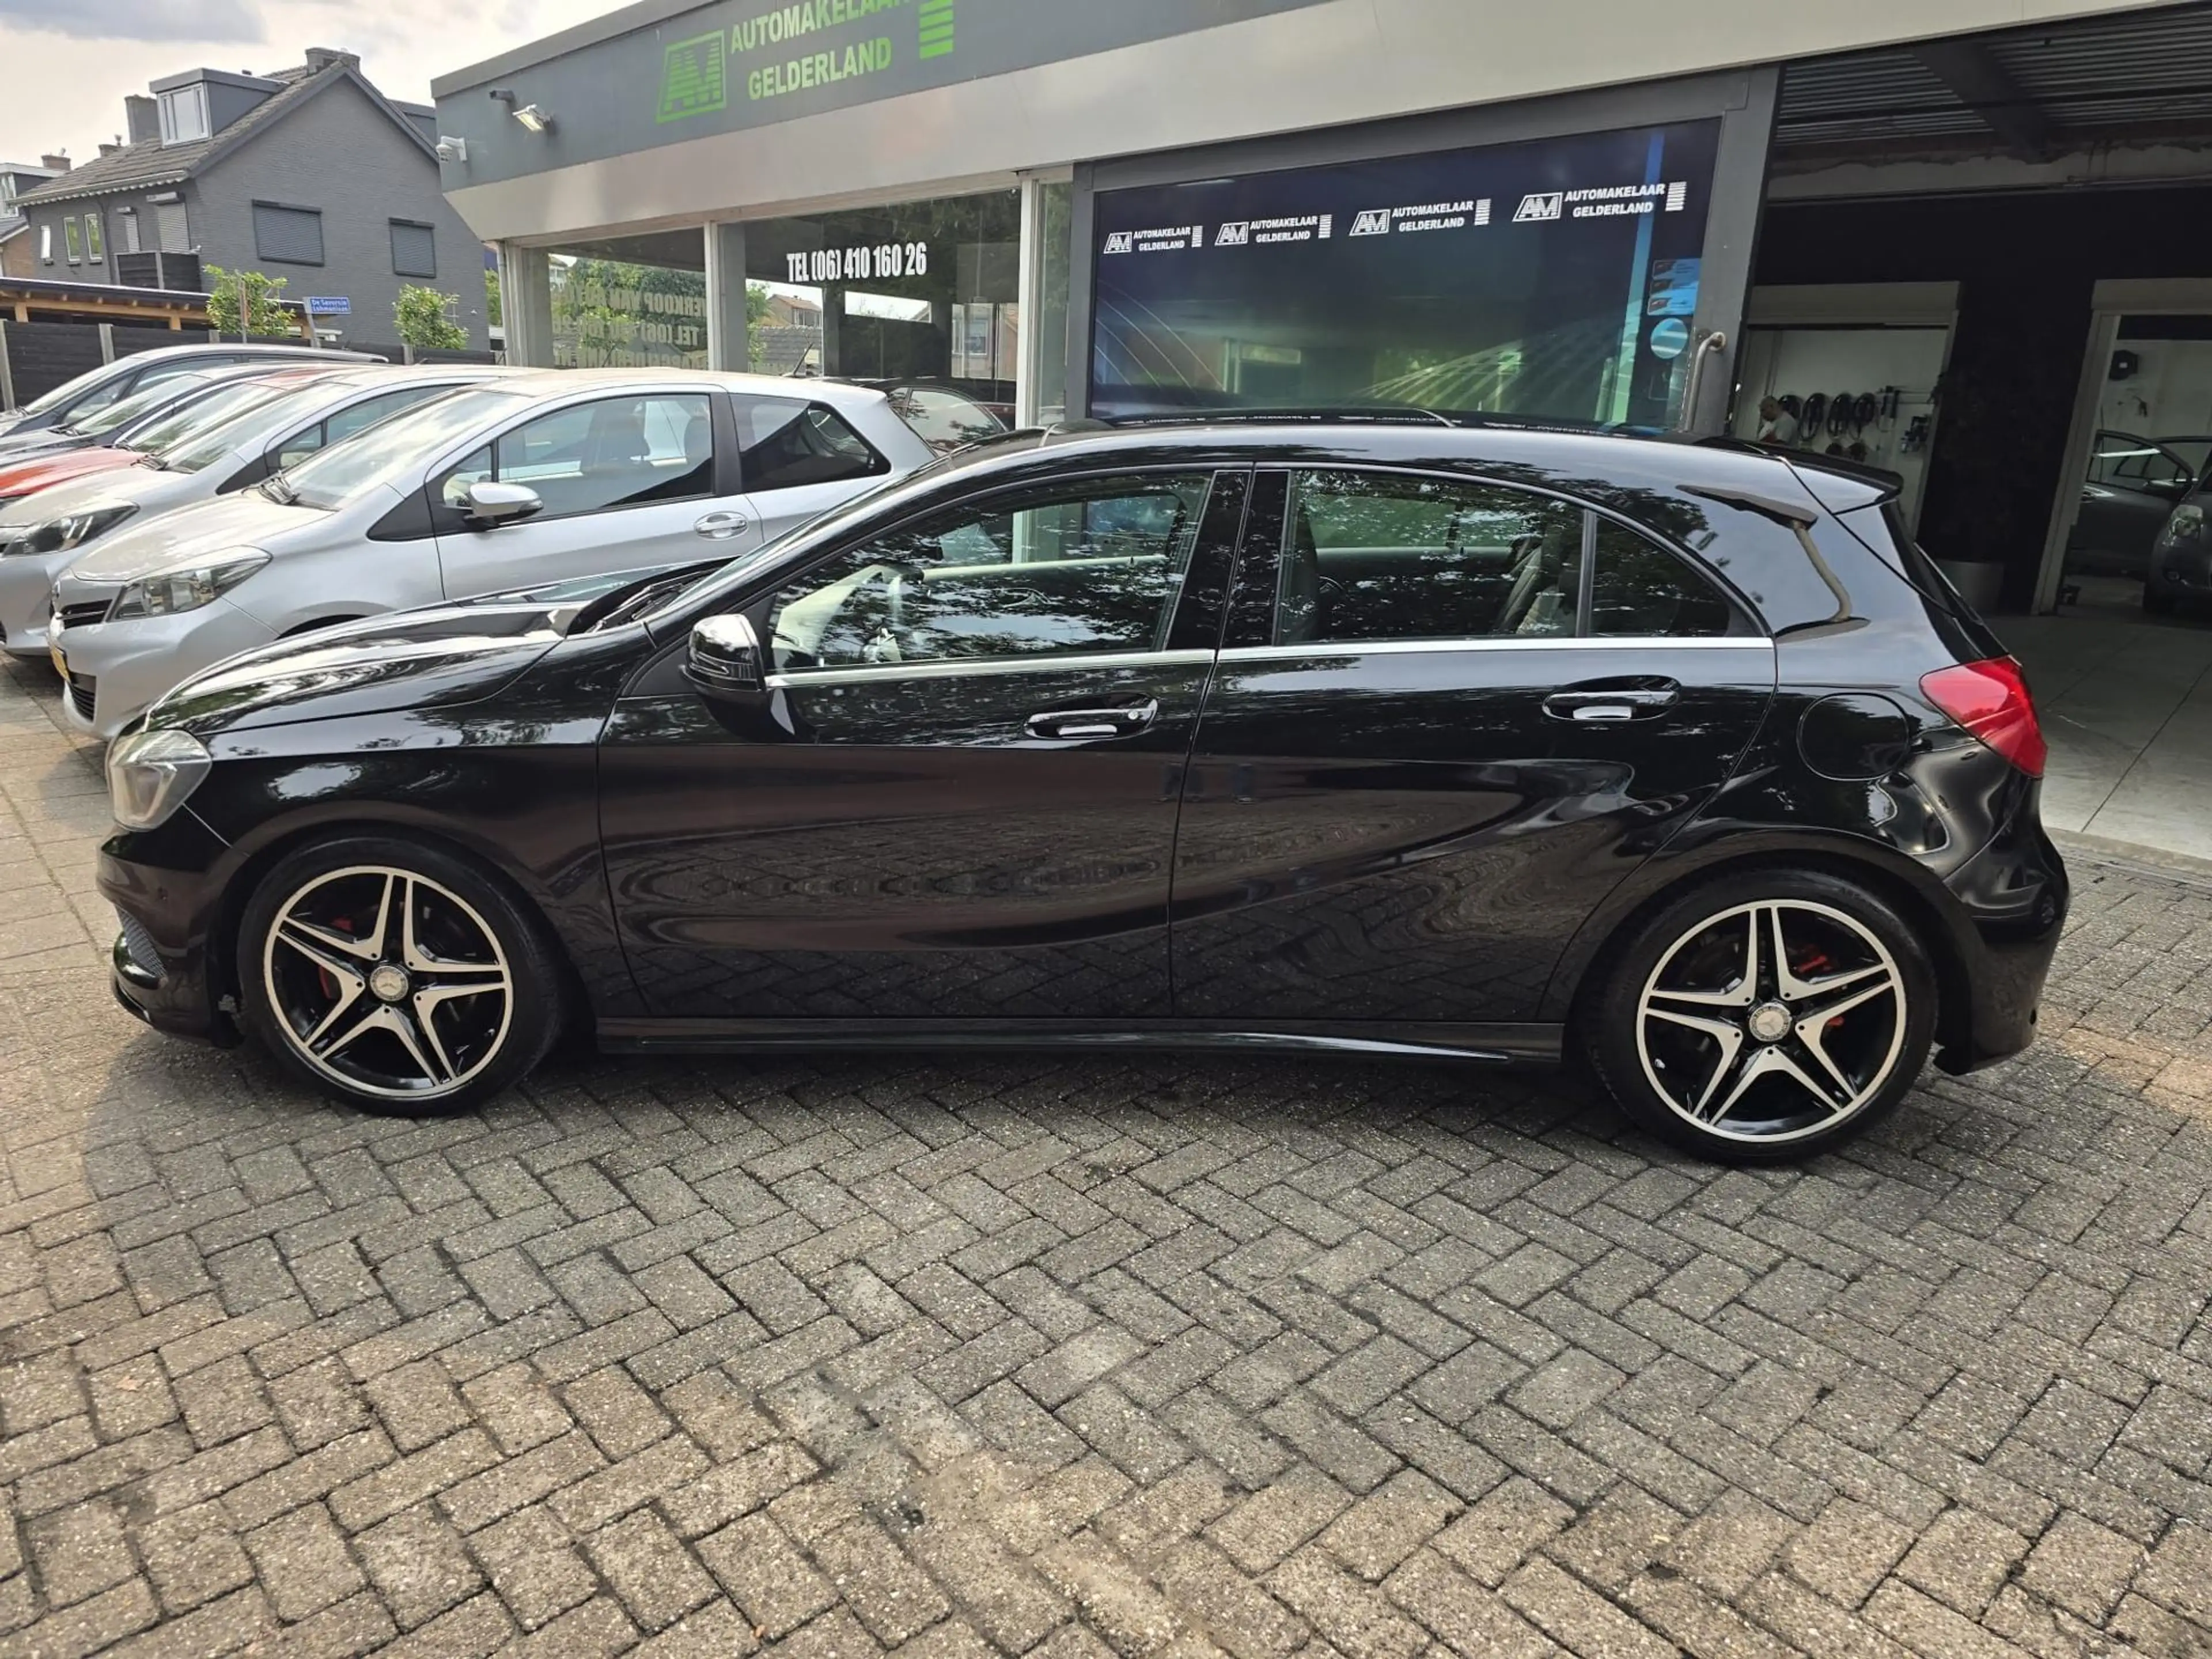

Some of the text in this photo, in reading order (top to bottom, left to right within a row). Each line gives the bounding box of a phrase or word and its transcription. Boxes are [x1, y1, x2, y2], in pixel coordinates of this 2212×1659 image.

[749, 37, 892, 100] GELDERLAND
[1565, 183, 1665, 202] AUTOMAKELAAR
[1392, 200, 1474, 217] AUTOMAKELAAR
[1573, 202, 1653, 218] GELDERLAND
[1250, 216, 1318, 230] AUTOMAKELAAR
[1399, 217, 1464, 232] GELDERLAND
[1134, 226, 1191, 240] AUTOMAKELAAR
[1256, 231, 1310, 243] GELDERLAND
[1138, 240, 1185, 252] GELDERLAND
[786, 241, 927, 282] TEL (06) 410 160 26
